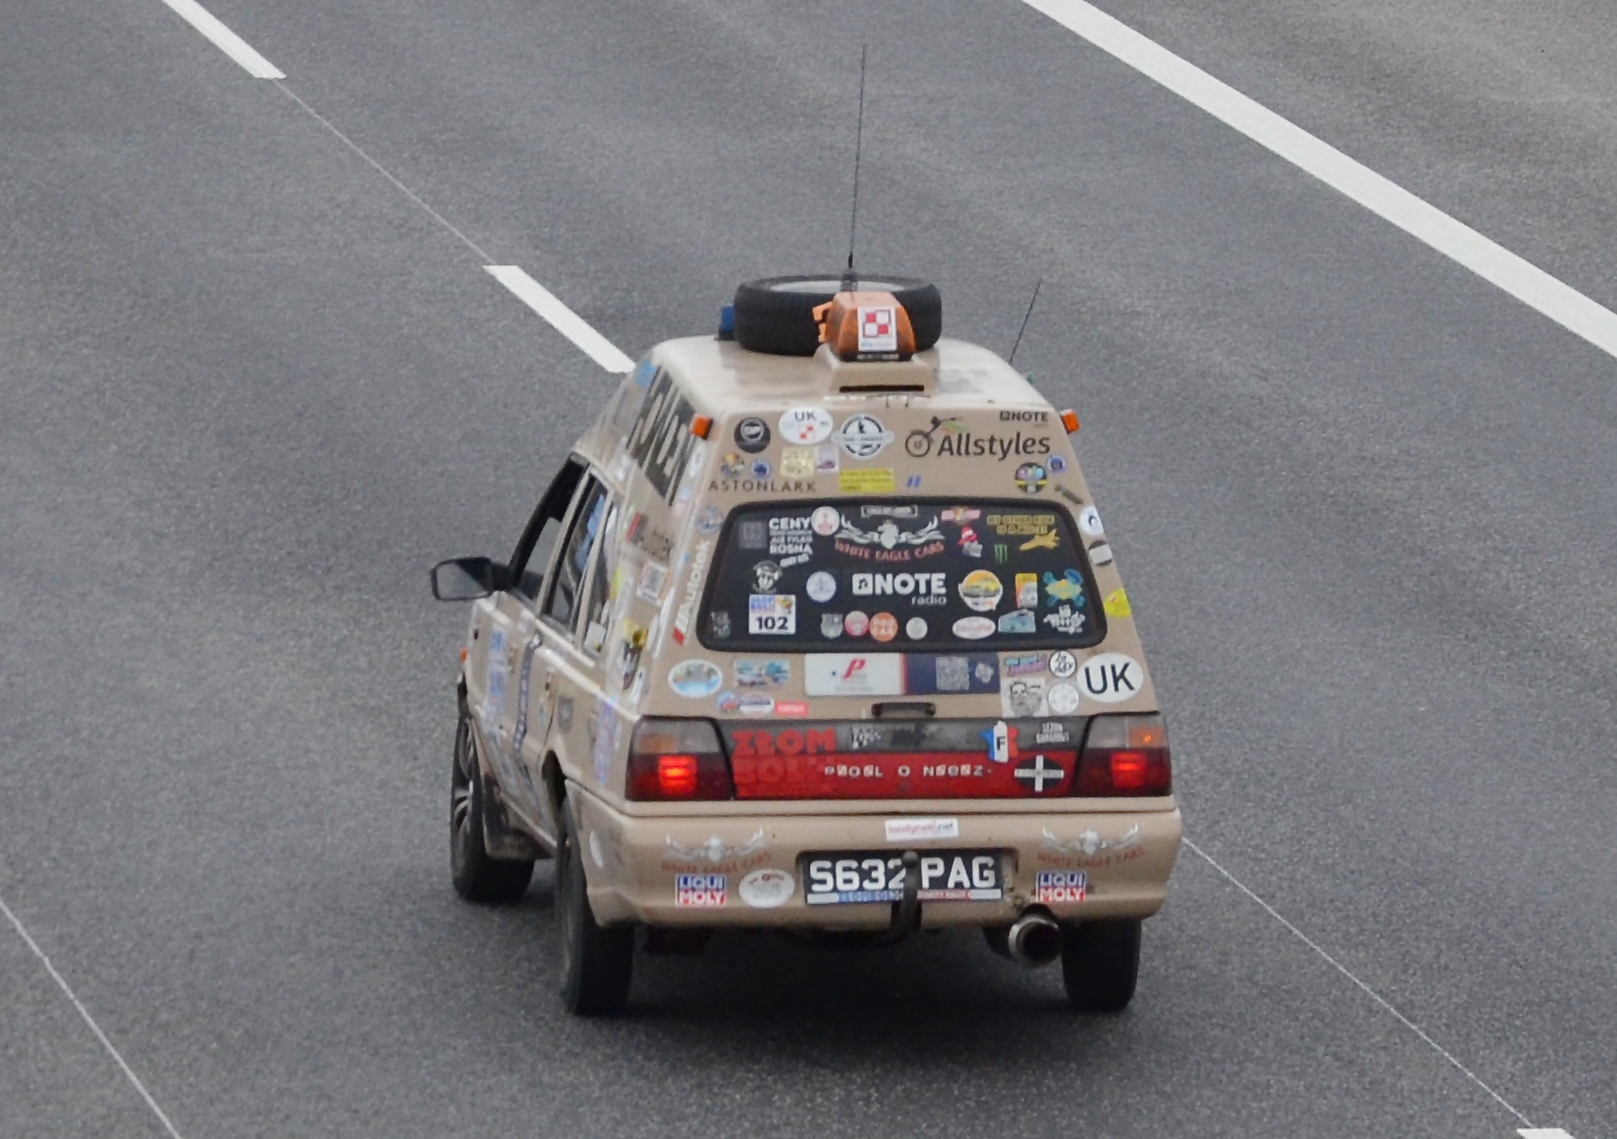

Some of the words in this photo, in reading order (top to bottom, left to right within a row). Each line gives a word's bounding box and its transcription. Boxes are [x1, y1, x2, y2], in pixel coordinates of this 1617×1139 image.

[794, 410, 817, 422] UK
[937, 431, 1051, 461] Allstyles
[708, 479, 817, 494] ASTONLARK
[835, 540, 871, 560] WHITE
[875, 549, 911, 561] EAGLE
[914, 541, 944, 558] CARS
[875, 572, 947, 595] NOTE
[911, 592, 947, 606] radio
[756, 616, 788, 630] 102
[1084, 662, 1135, 695] UK
[997, 736, 1006, 750] F
[809, 858, 907, 893] S632
[920, 856, 996, 890] PAG
[1039, 871, 1085, 887] LIQUI
[679, 875, 725, 890] LIQUI
[679, 890, 725, 906] MOLY
[1039, 887, 1085, 902] MOLY
